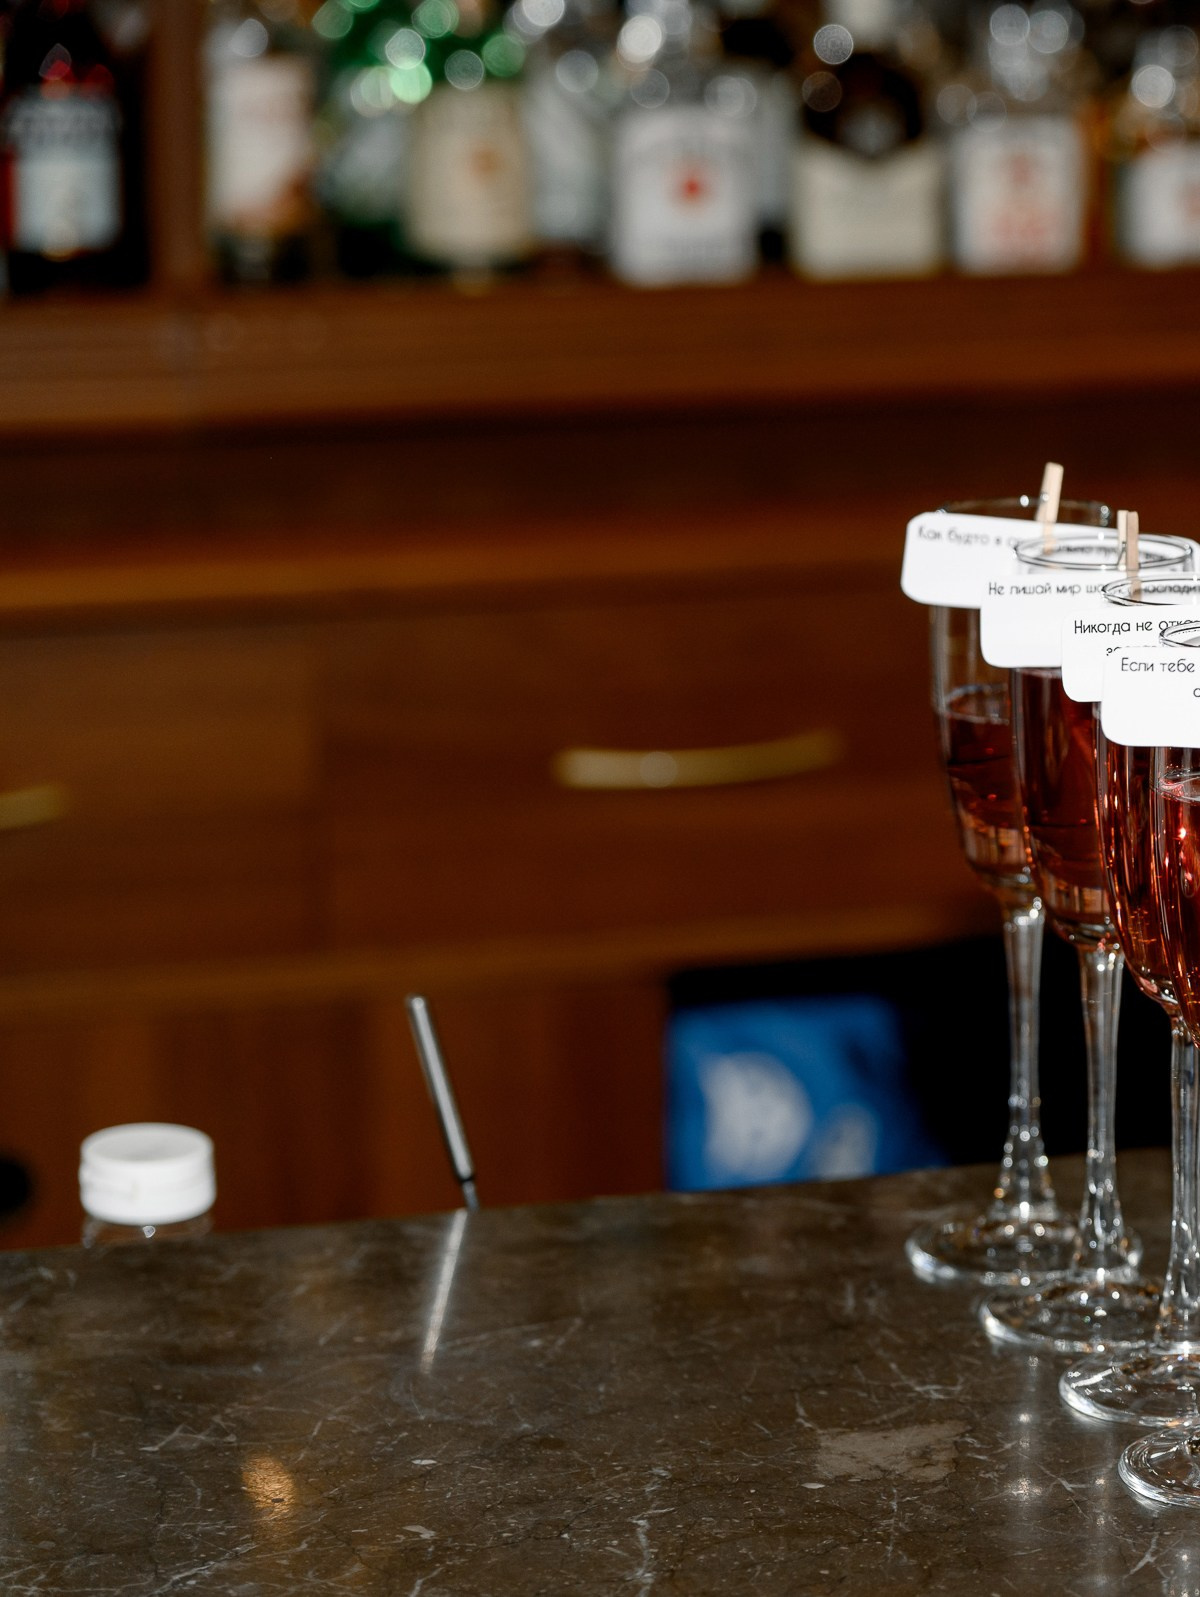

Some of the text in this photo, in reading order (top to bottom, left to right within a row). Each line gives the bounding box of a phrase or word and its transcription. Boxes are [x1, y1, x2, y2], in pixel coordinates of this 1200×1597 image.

[988, 582, 1005, 596] Не
[1010, 583, 1051, 596] лишай
[1056, 585, 1082, 596] мир
[1074, 620, 1131, 635] Никогда
[1136, 621, 1153, 631] не
[1121, 657, 1154, 672] Если
[1160, 659, 1195, 672] тебе
